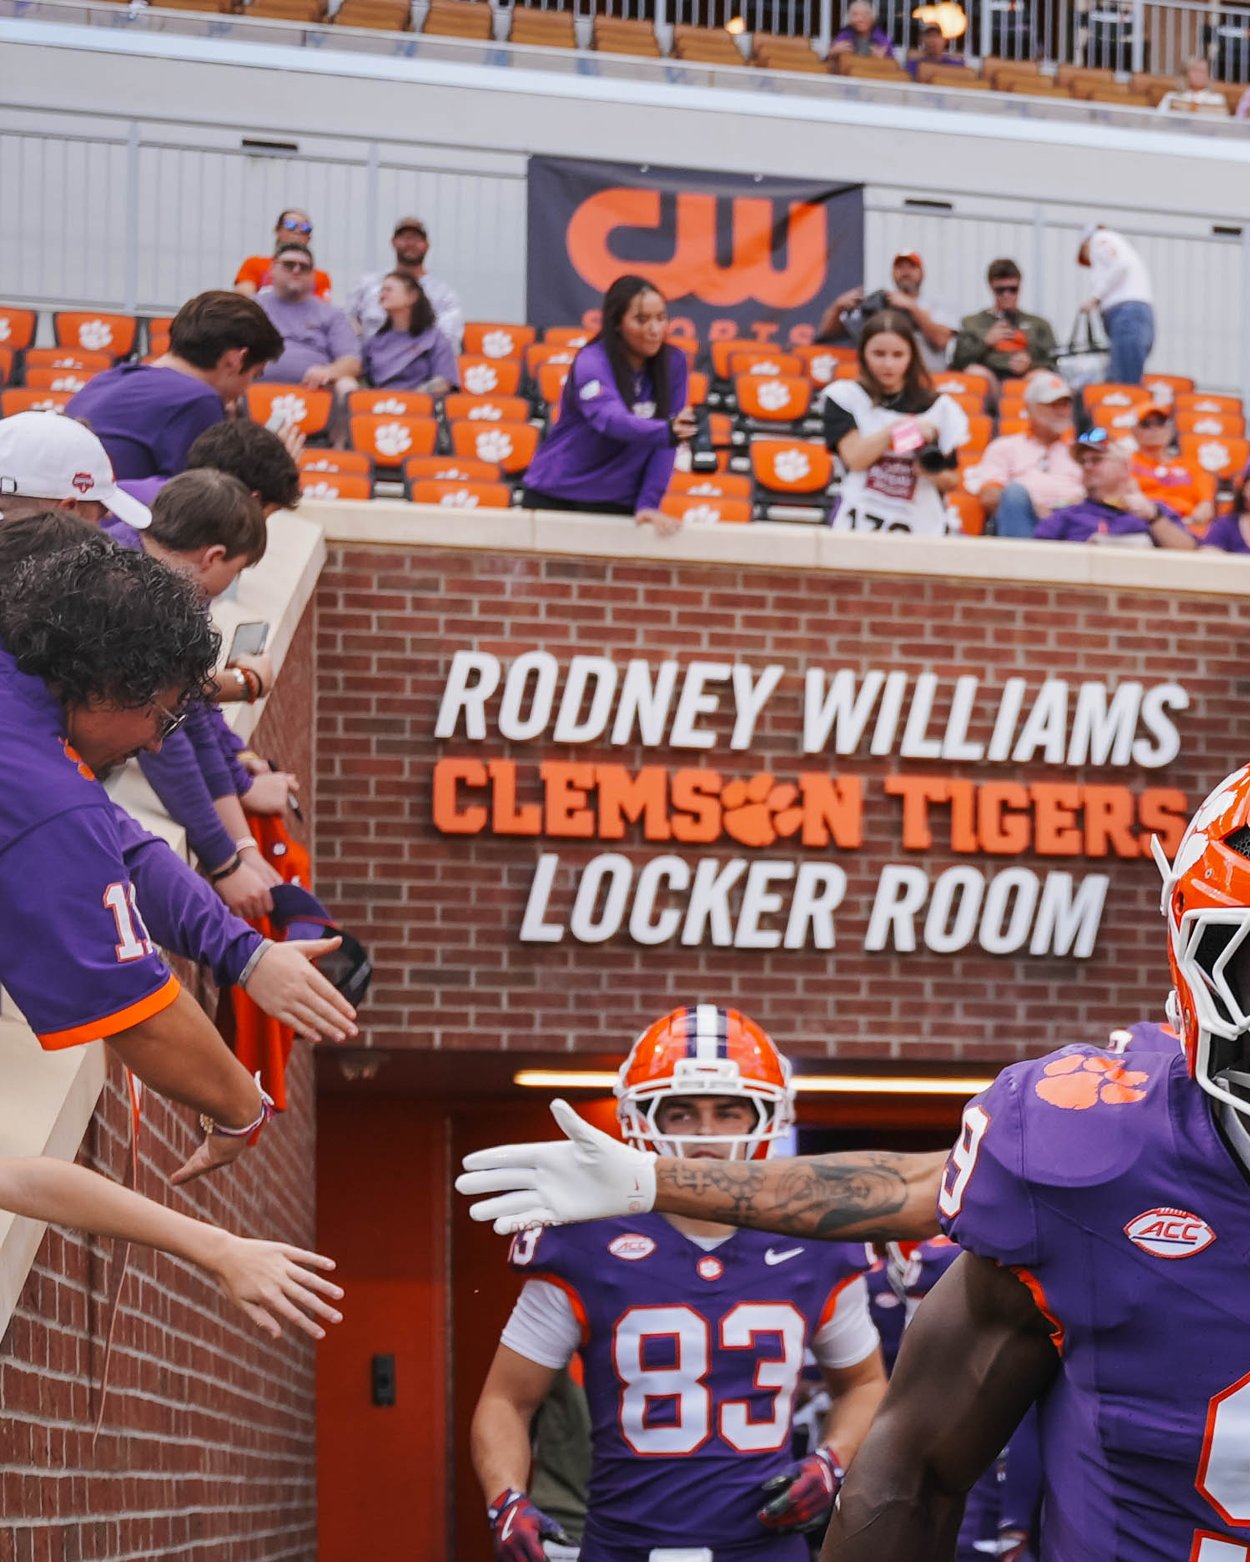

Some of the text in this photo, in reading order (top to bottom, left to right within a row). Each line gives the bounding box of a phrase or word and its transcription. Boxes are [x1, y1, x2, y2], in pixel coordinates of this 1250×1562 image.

[433, 650, 1191, 768] RODNEY WILLIAMS
[432, 756, 1189, 859] CLEMSN TIGERS
[103, 882, 154, 964] 1
[519, 852, 1110, 959] LOCKER ROOM
[1137, 1220, 1203, 1241] ACC
[611, 1301, 807, 1457] 83
